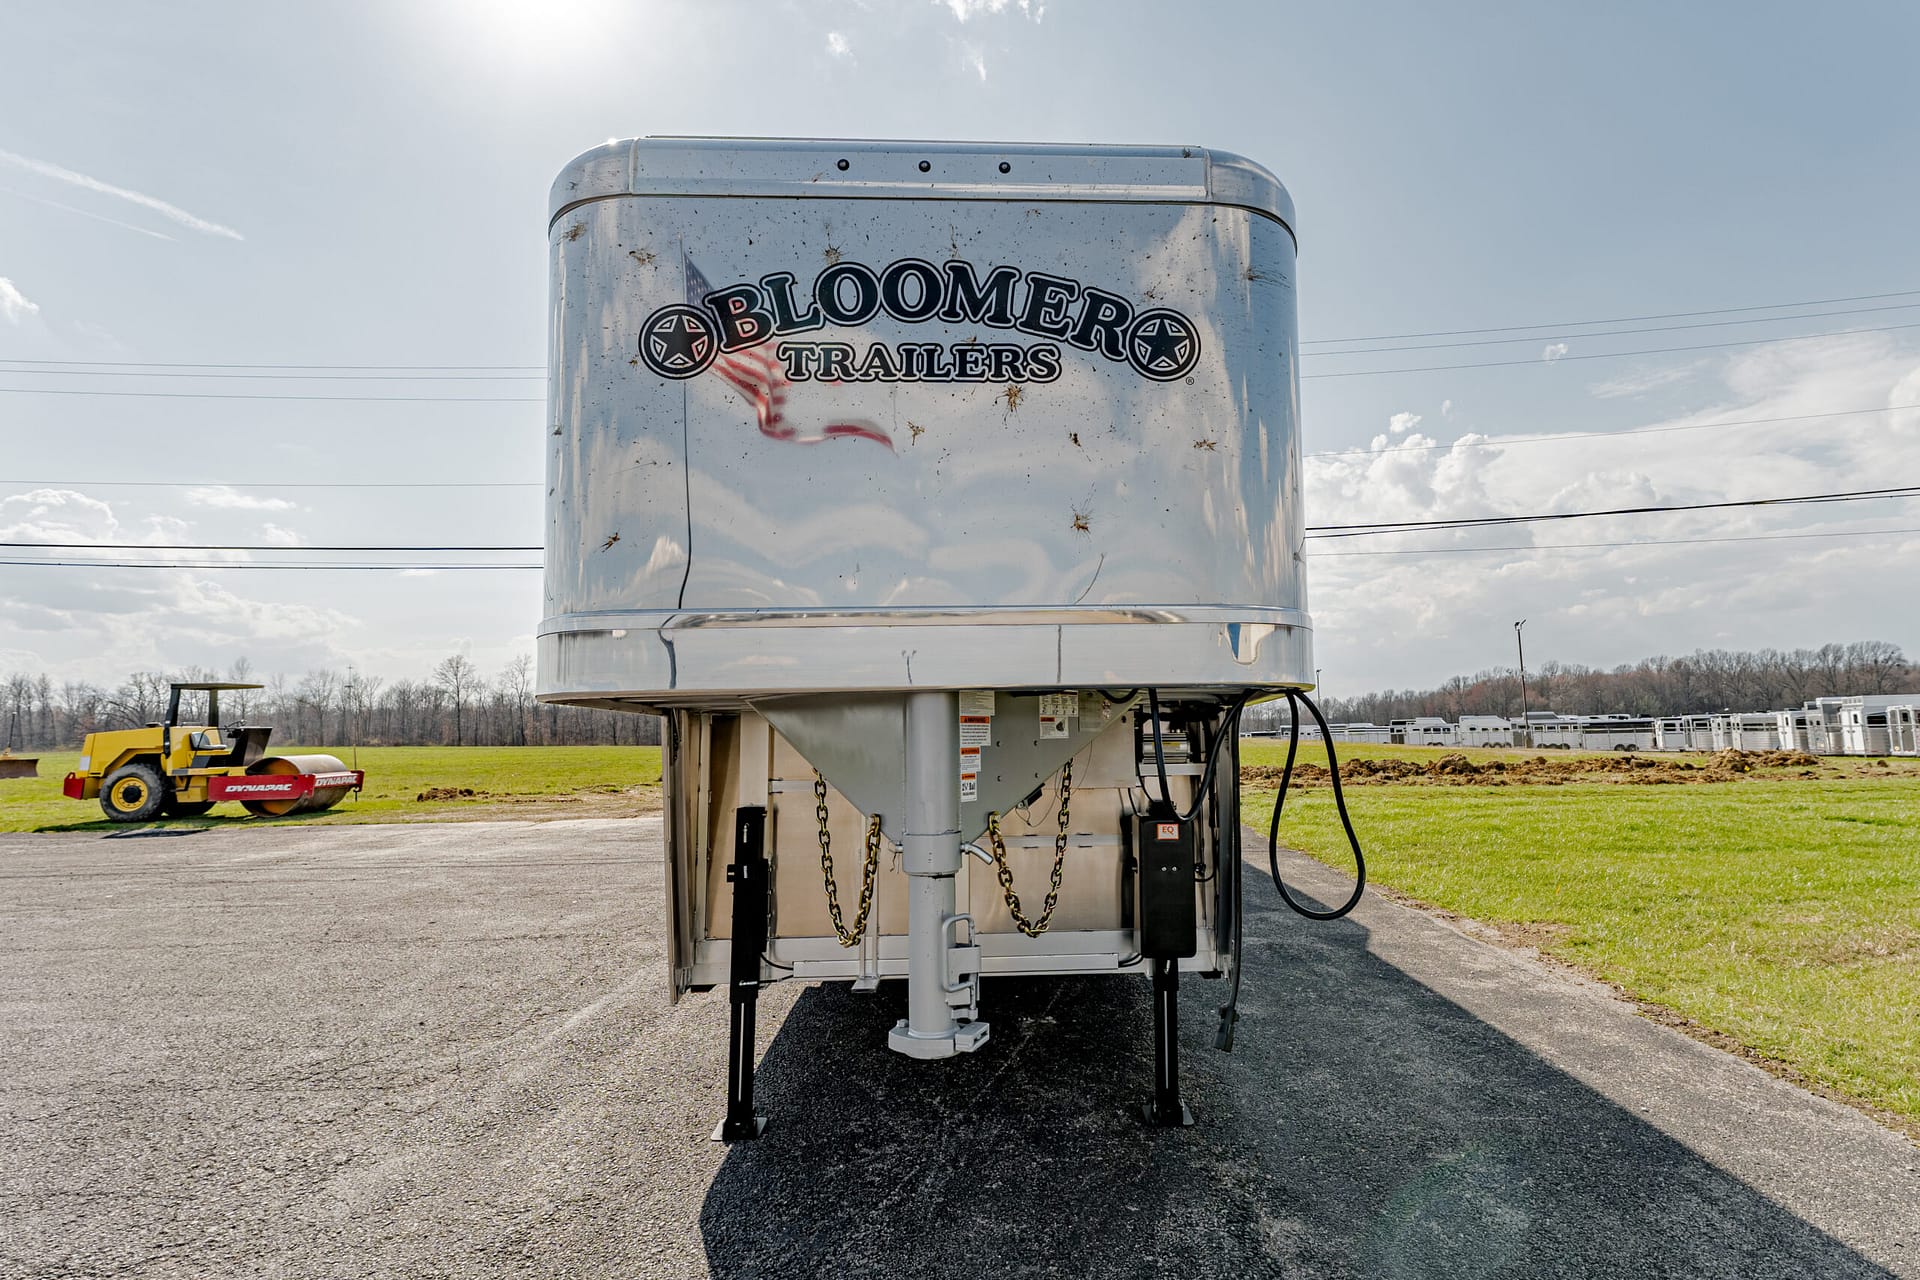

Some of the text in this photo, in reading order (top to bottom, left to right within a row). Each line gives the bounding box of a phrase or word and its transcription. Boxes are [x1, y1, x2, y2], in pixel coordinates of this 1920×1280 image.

[707, 258, 1132, 361] BLOOMER
[777, 343, 1062, 384] TRAILERS
[314, 776, 357, 787] DYNAPAC
[225, 784, 292, 792] DYNAPAC
[1162, 826, 1174, 835] EQ
